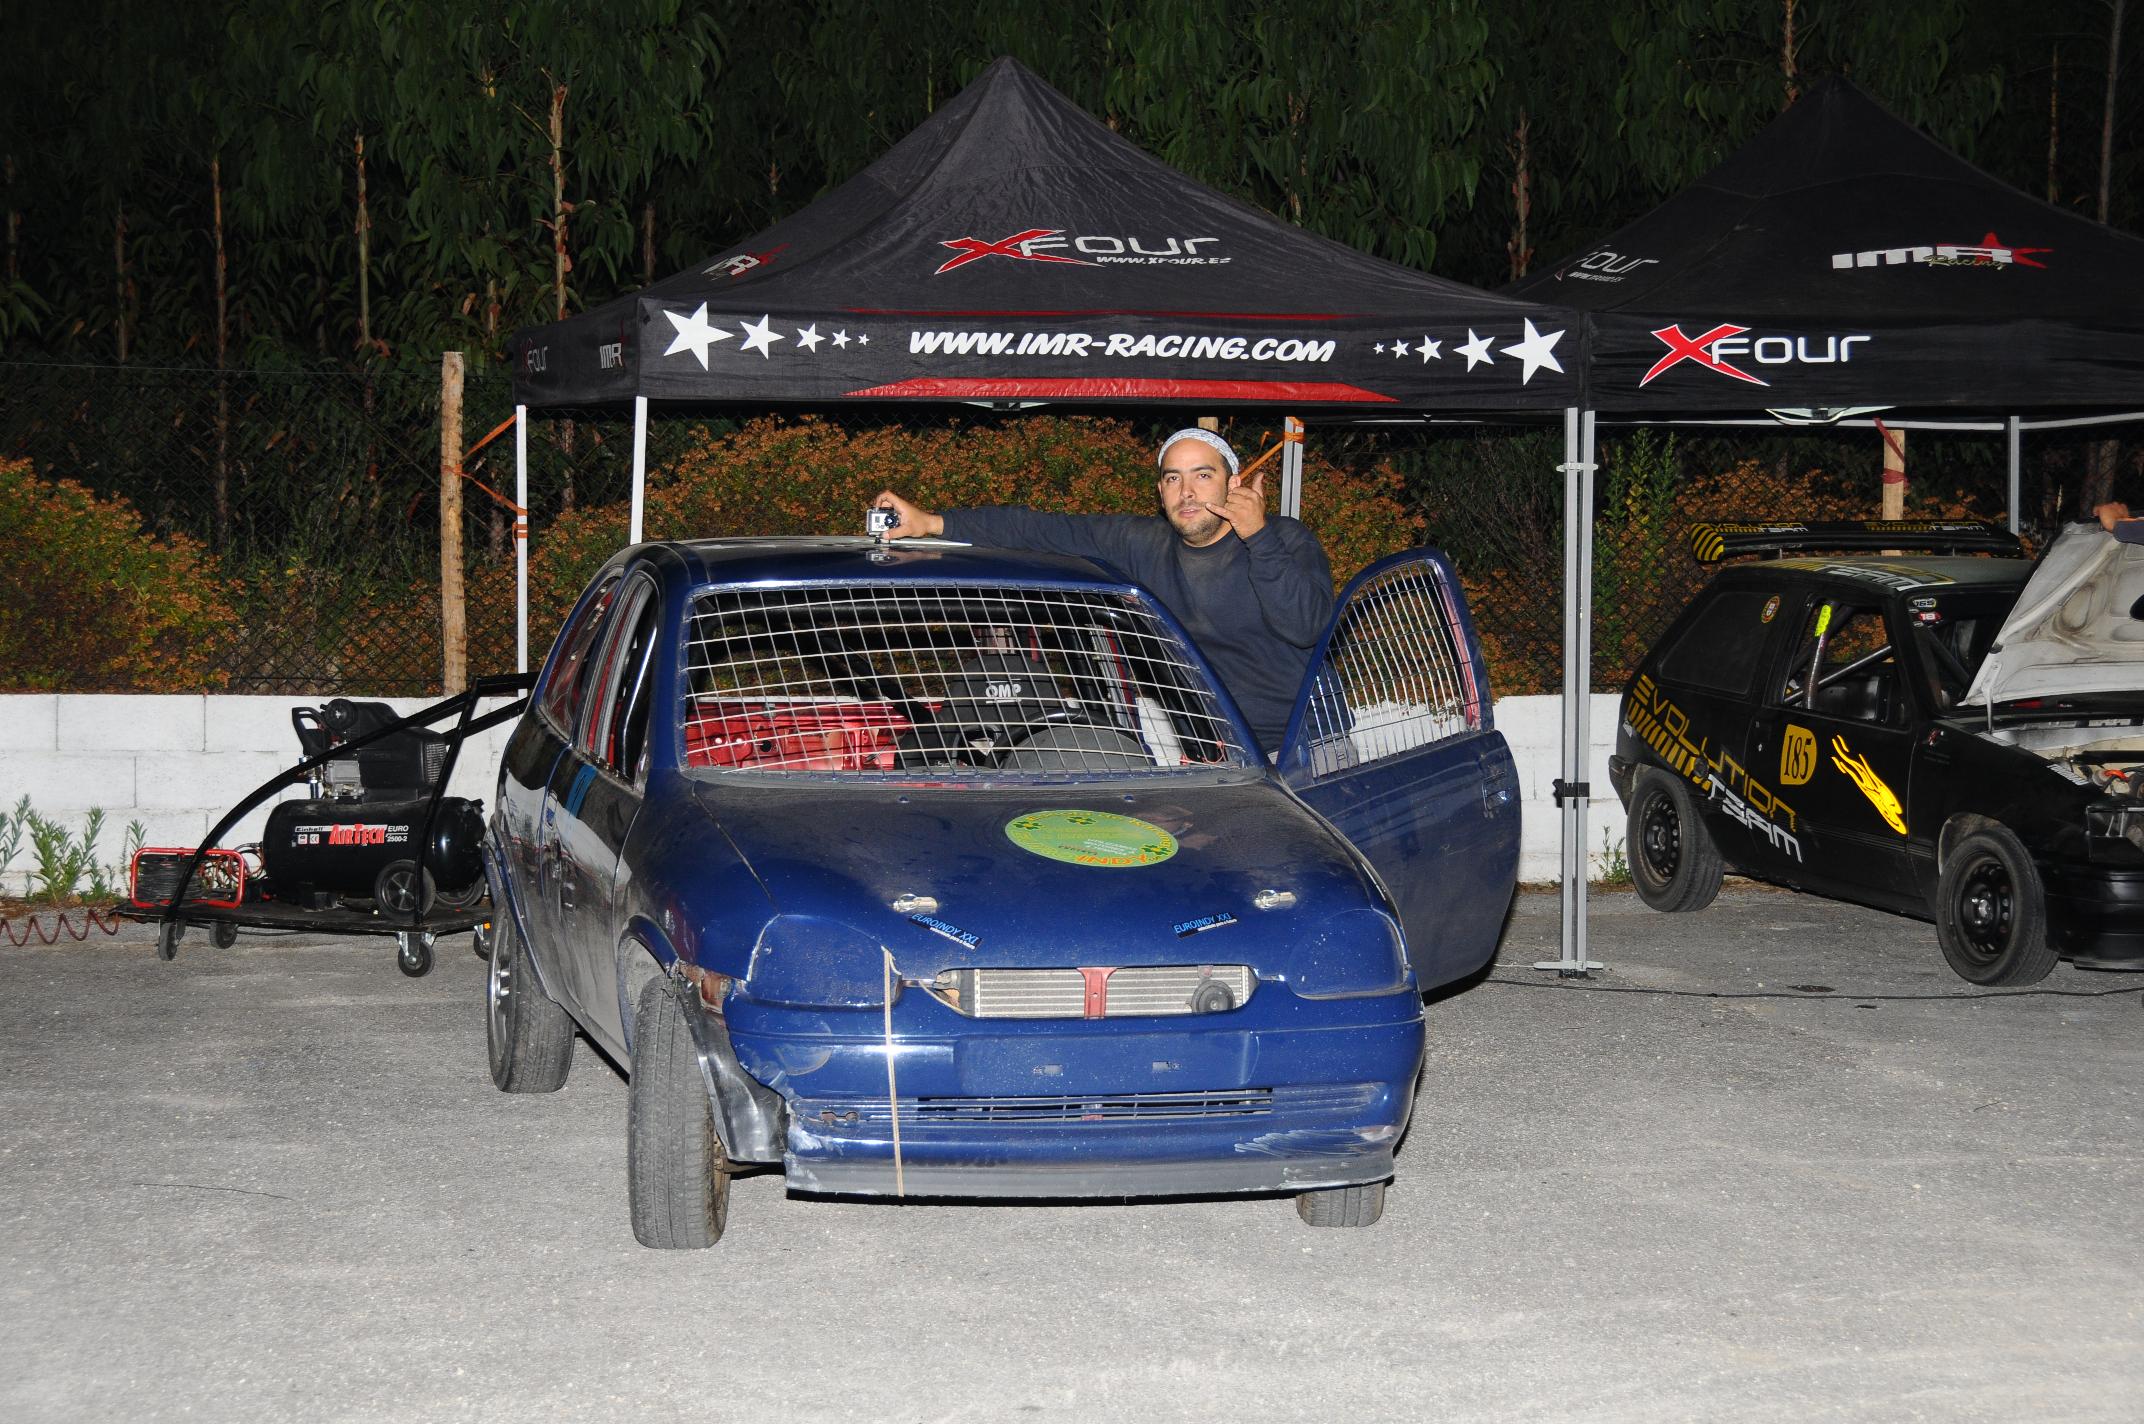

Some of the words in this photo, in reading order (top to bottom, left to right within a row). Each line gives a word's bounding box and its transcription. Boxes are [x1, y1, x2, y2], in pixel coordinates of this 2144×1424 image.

[909, 331, 1337, 362] WWW.IMR-RACING.COM
[985, 684, 1021, 698] OMP
[1784, 735, 1813, 780] 185
[388, 824, 409, 833] EURO
[912, 913, 961, 936] EUROINDY
[959, 931, 980, 945] XXI
[1173, 915, 1216, 934] EUROINDY
[1216, 912, 1232, 922] XXI
